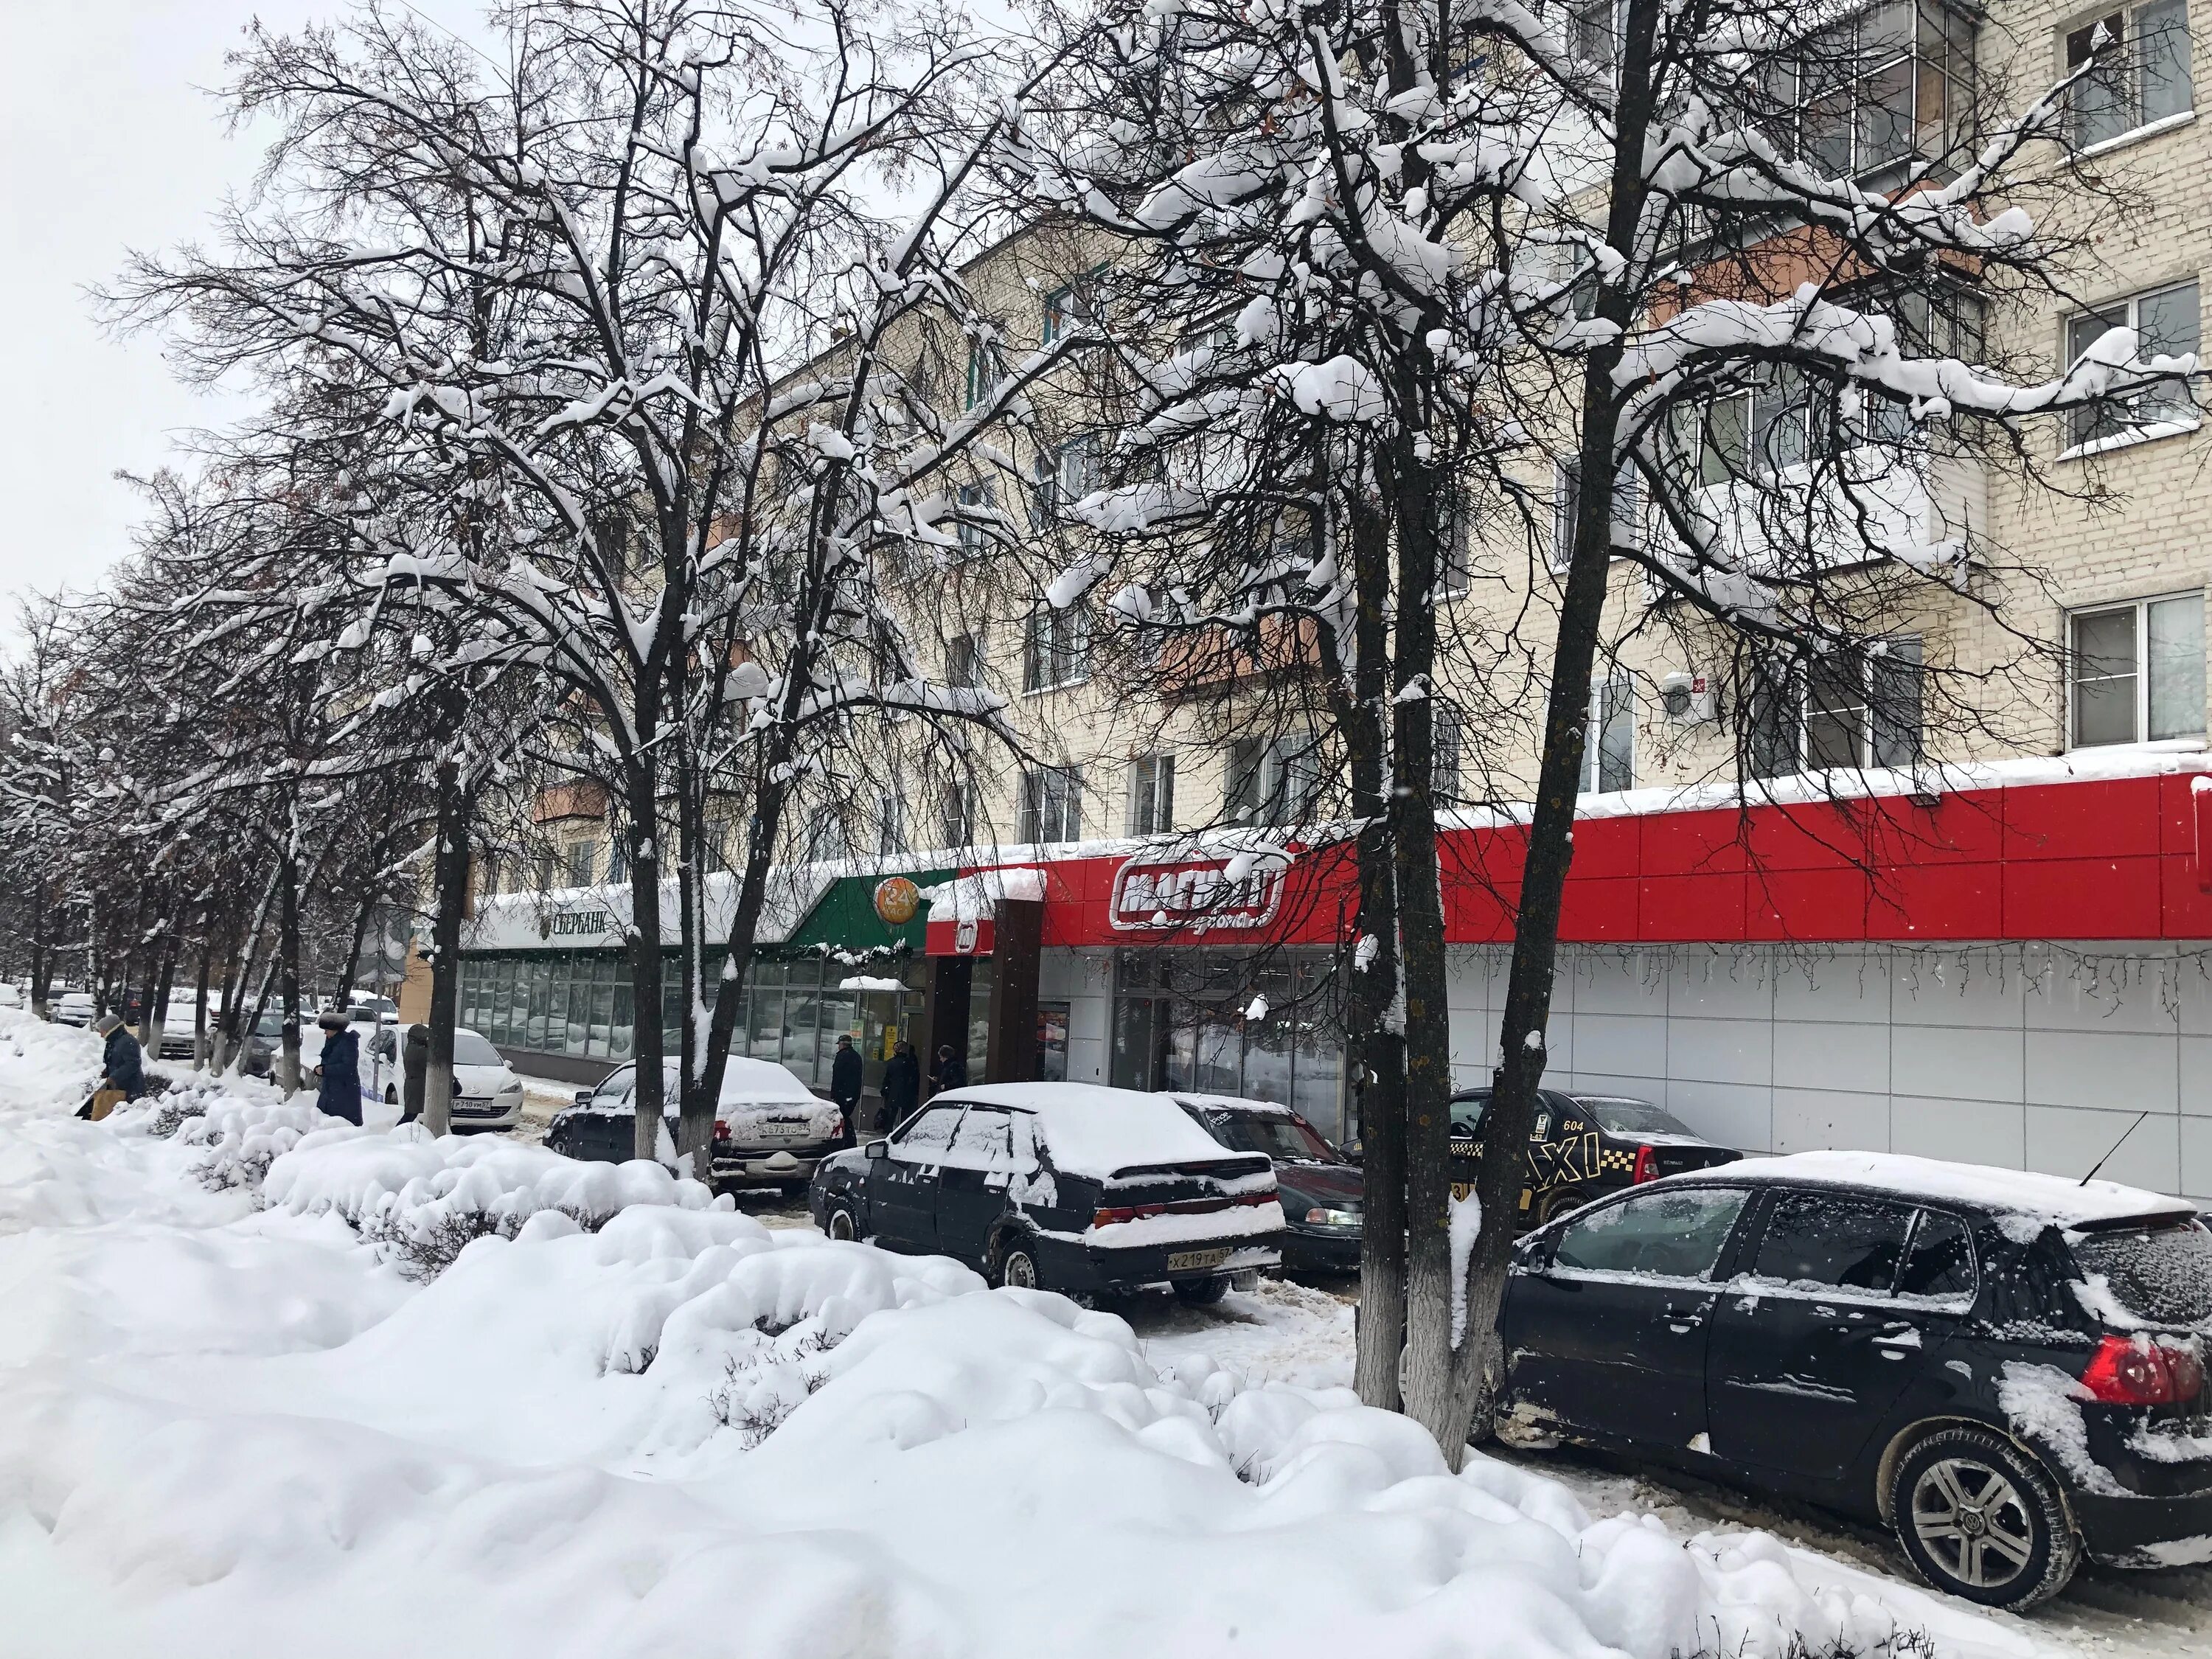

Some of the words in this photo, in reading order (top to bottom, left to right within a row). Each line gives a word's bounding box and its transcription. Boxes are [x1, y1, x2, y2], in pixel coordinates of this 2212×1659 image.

[885, 887, 910, 906] 24
[553, 911, 608, 935] СБЕРБАНК
[1563, 1119, 1585, 1132] 604
